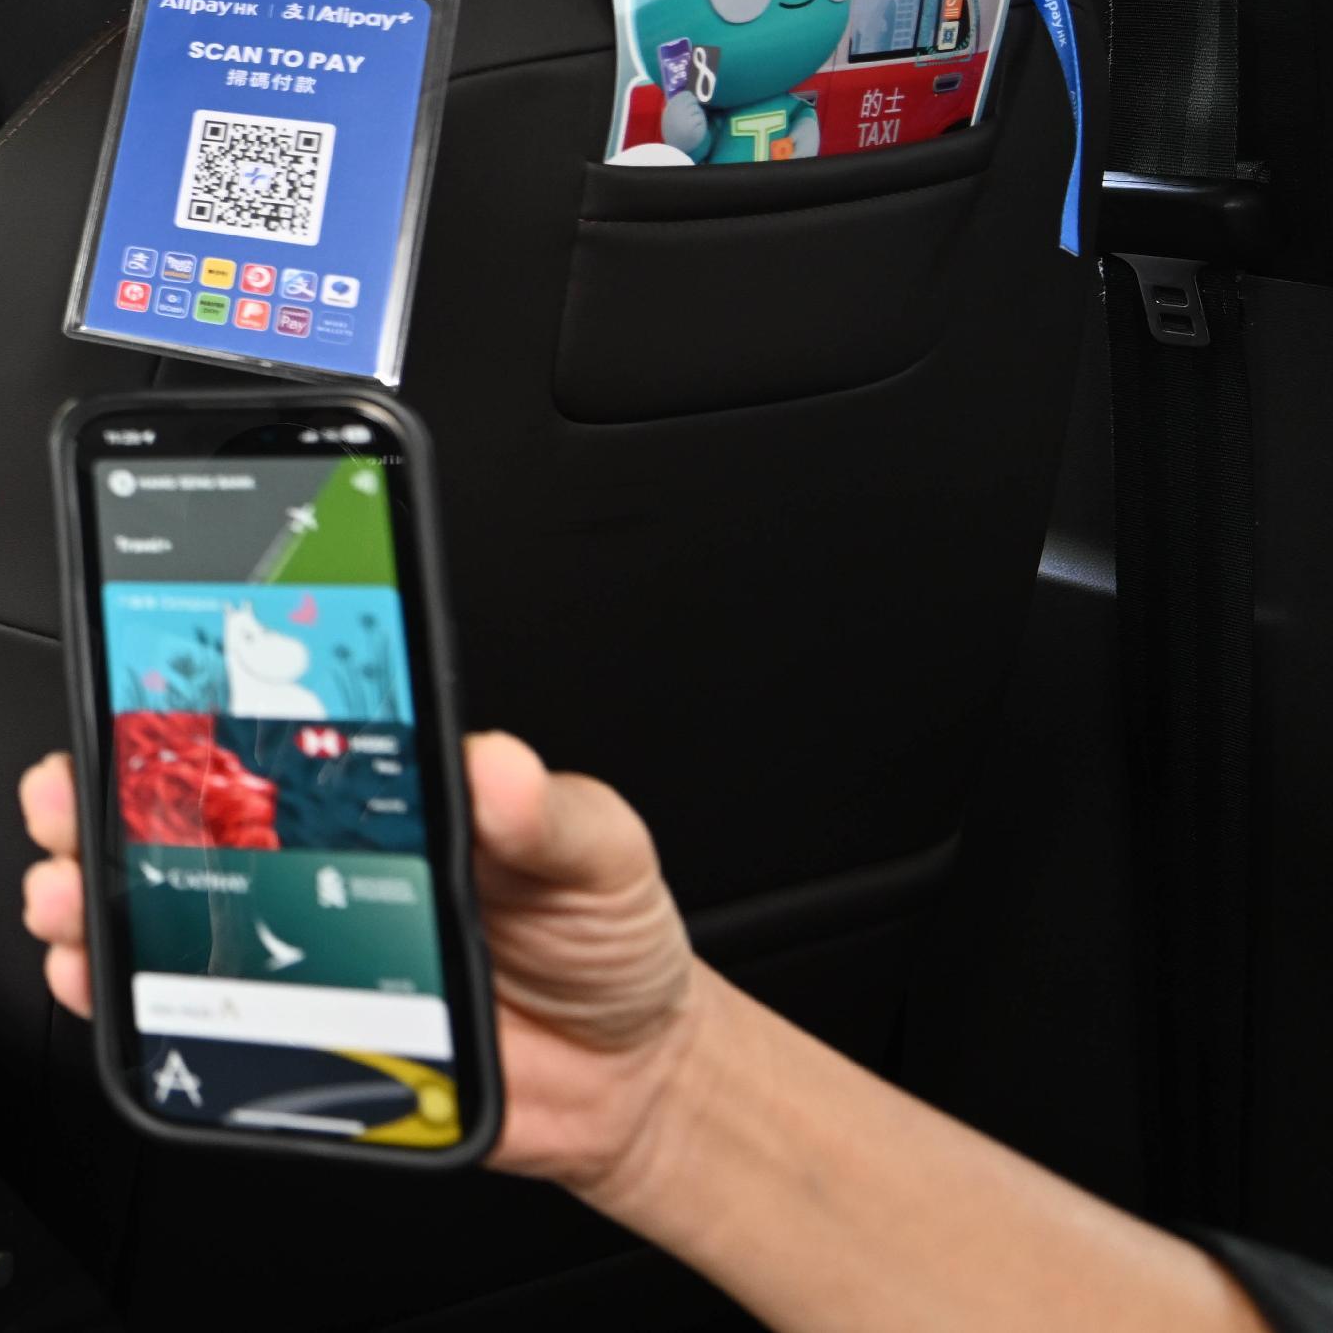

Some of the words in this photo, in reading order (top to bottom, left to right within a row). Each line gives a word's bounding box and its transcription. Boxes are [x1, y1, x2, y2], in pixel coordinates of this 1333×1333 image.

[188, 41, 263, 65] SCAN
[268, 47, 305, 68] TO
[308, 52, 366, 74] PAY
[226, 68, 318, 95] 掃碼付款
[860, 87, 906, 118] 的士
[857, 118, 901, 149] TAXI
